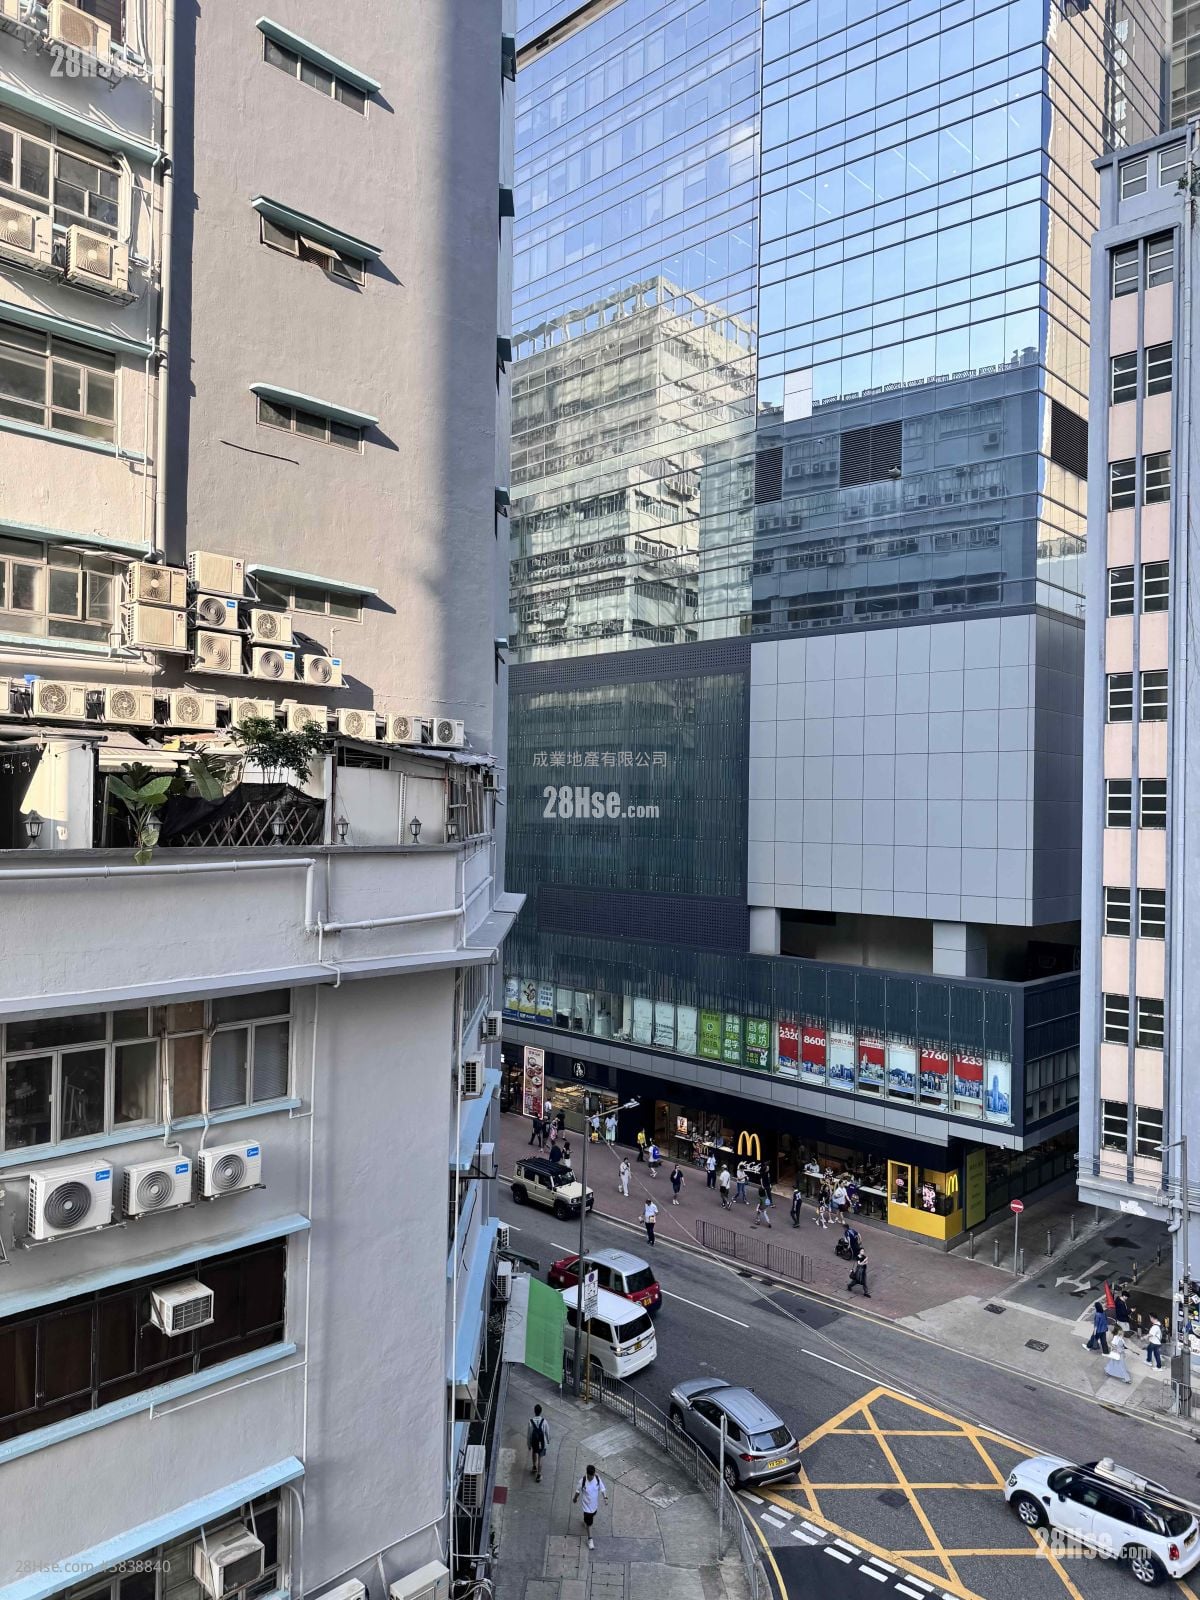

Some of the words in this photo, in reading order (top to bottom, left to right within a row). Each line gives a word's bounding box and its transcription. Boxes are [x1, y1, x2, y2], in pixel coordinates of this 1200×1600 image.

[803, 1035, 826, 1047] 8600
[921, 1049, 948, 1062] 2760
[955, 1053, 983, 1066] 1233
